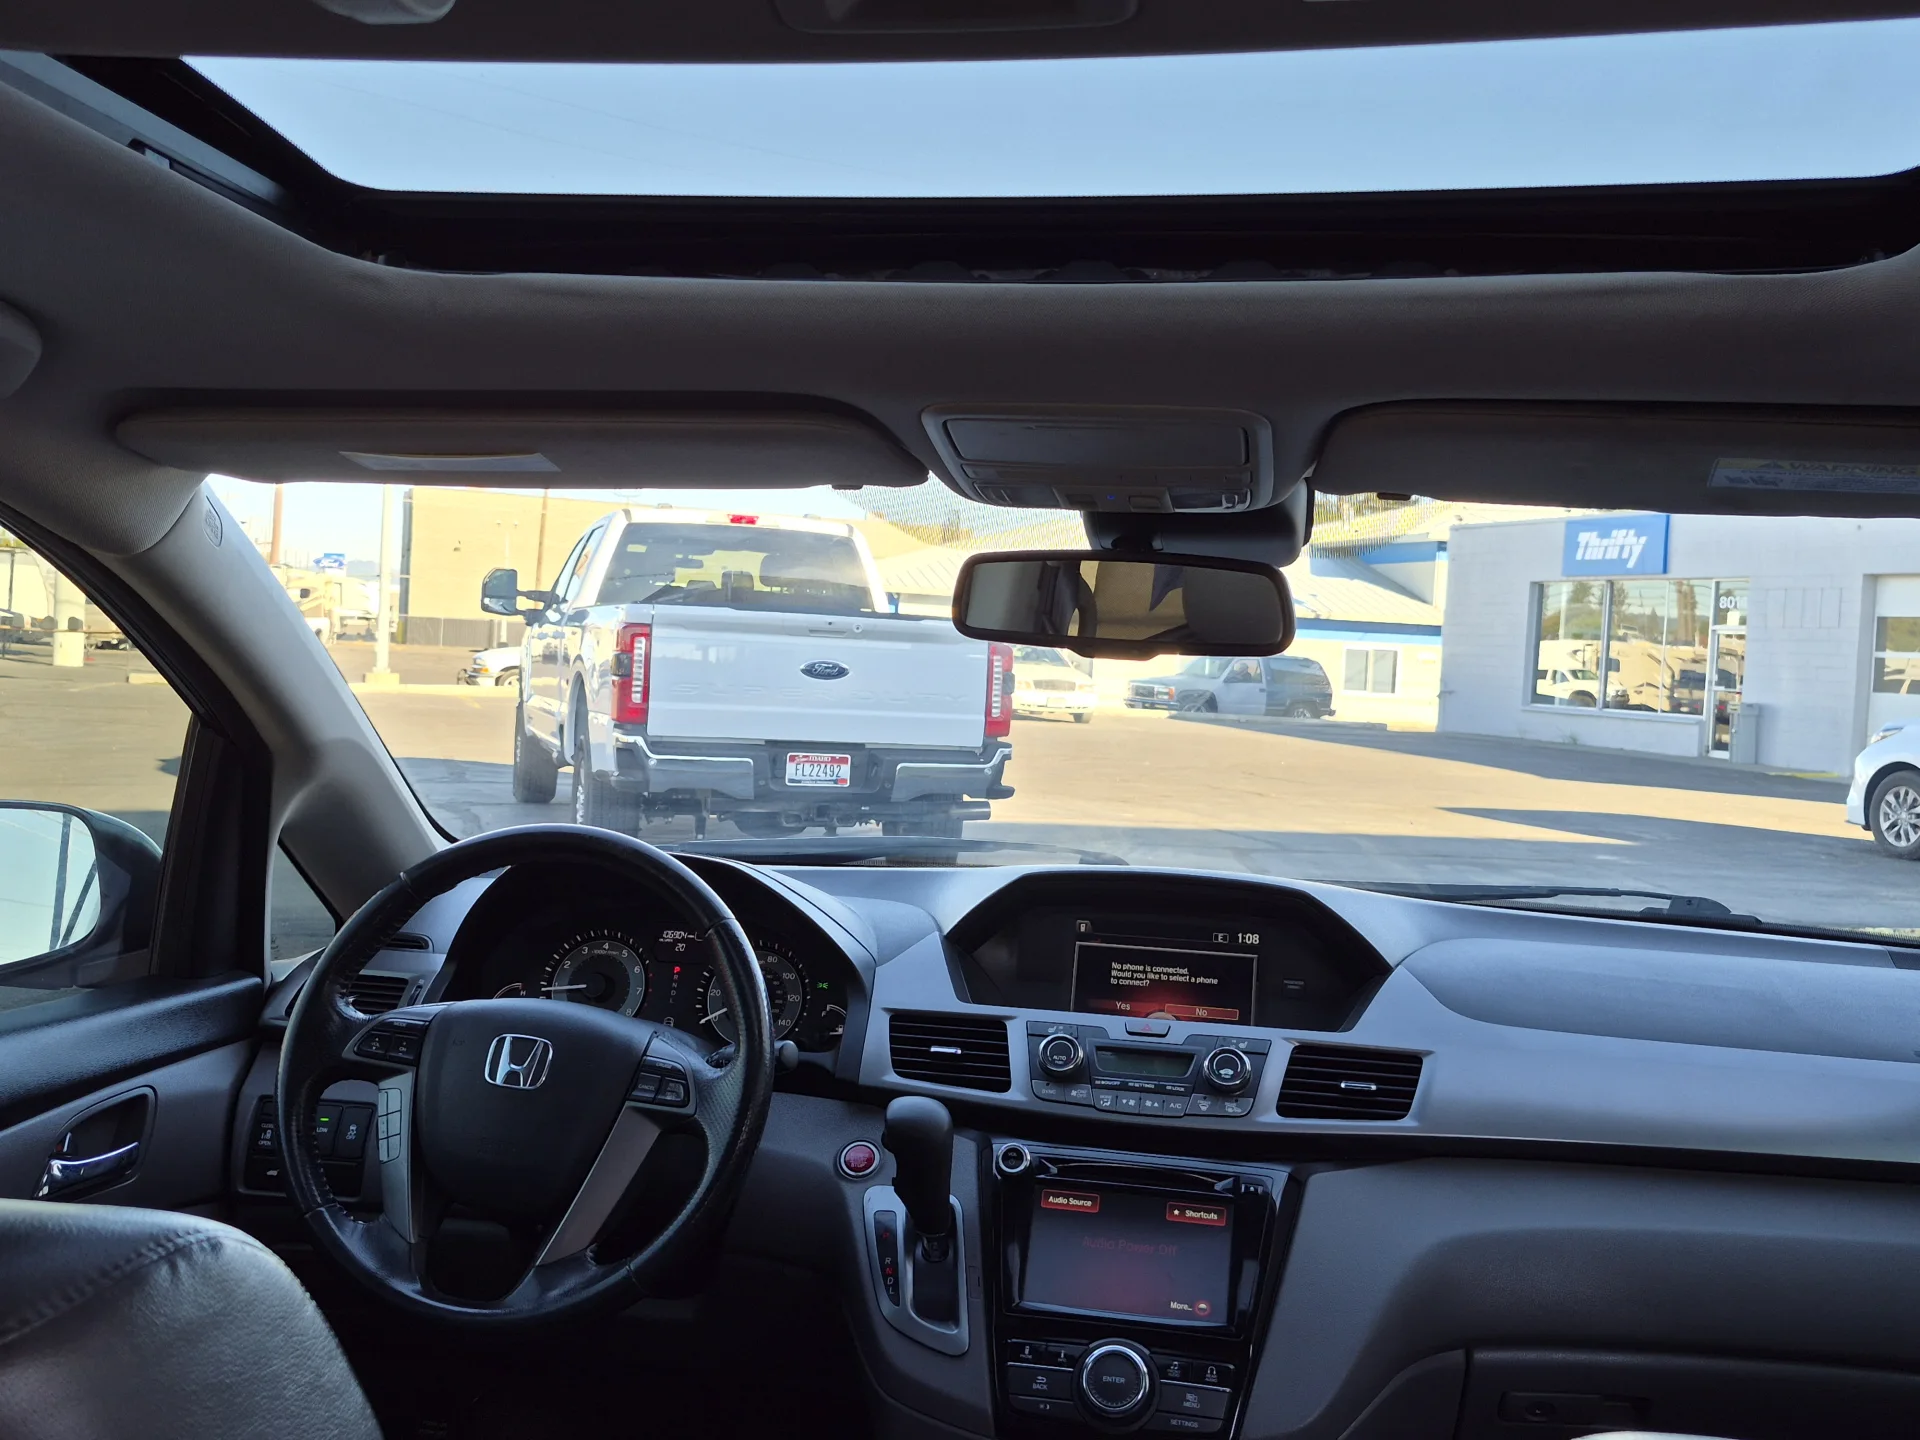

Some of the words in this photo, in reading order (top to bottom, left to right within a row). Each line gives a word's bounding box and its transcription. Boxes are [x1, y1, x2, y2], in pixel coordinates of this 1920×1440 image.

[1575, 528, 1649, 569] Thrifty
[811, 663, 841, 677] Ford
[795, 763, 842, 778] FL22492
[1237, 932, 1260, 945] 1:08
[581, 946, 589, 954] 3
[602, 942, 609, 950] 4
[621, 949, 628, 958] 5
[563, 961, 571, 969] 2
[634, 965, 641, 974] 6
[1111, 961, 1122, 970] No
[1122, 963, 1145, 971] phone
[782, 972, 796, 980] 100
[1111, 969, 1132, 978] Would
[1146, 972, 1160, 980] like
[1160, 973, 1168, 981] to
[1169, 975, 1190, 983] select
[1196, 976, 1219, 985] phone
[1110, 977, 1118, 985] to
[1118, 979, 1150, 987] connect?
[635, 987, 643, 995] 7
[787, 994, 800, 1002] 120
[1116, 1001, 1131, 1011] Yes
[625, 1008, 633, 1017] 8
[1195, 1007, 1208, 1017] No
[777, 1019, 792, 1027] 140
[1048, 1195, 1068, 1205] Audio
[1068, 1197, 1092, 1208] Source
[1185, 1209, 1218, 1220] Shortcuts
[884, 1257, 892, 1265] R
[885, 1267, 893, 1275] N
[887, 1276, 894, 1285] D
[889, 1286, 895, 1295] L
[1102, 1375, 1126, 1384] ENTER
[1183, 1401, 1200, 1409] MENU
[1170, 1419, 1199, 1429] SETTINGS
